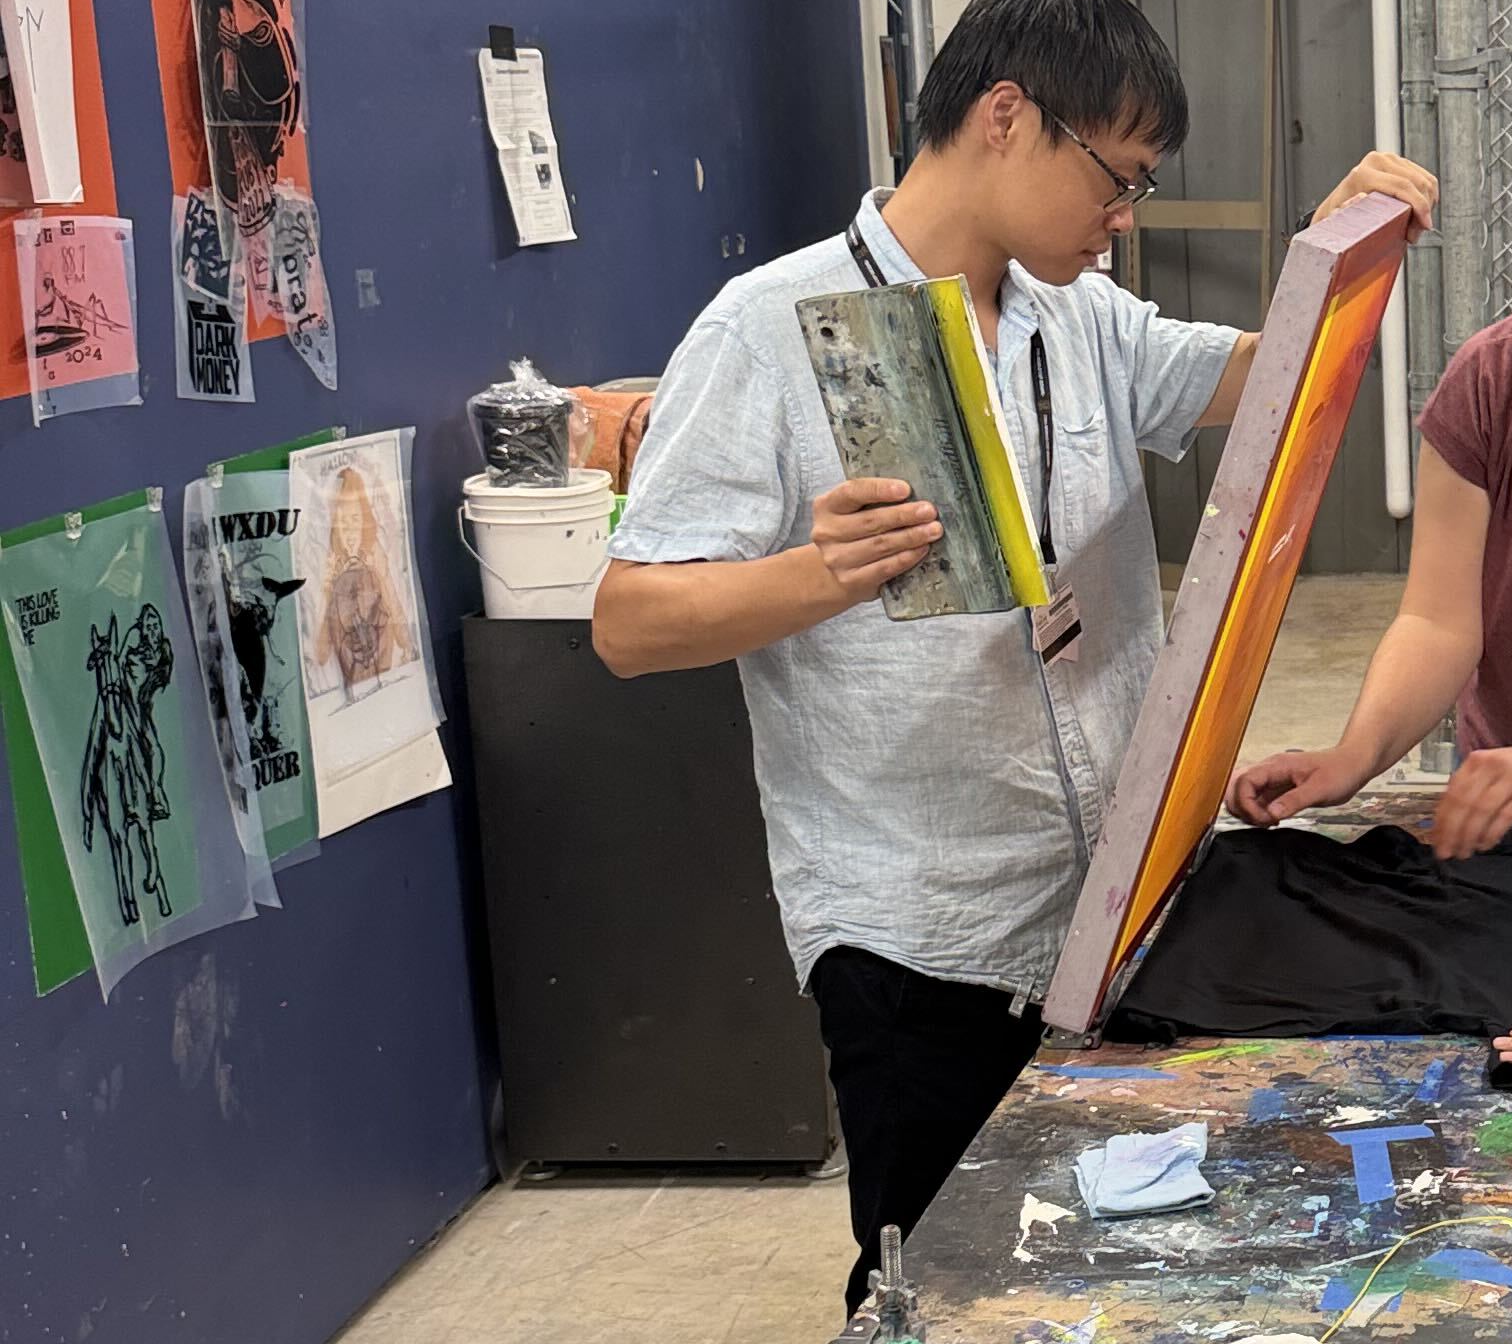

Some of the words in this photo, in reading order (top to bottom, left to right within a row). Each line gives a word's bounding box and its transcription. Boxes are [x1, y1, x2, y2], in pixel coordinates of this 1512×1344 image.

[65, 345, 103, 363] 2024
[195, 321, 238, 357] DARK
[196, 358, 241, 396] MONEY
[15, 594, 36, 615] THIS
[36, 587, 59, 609] LOVE
